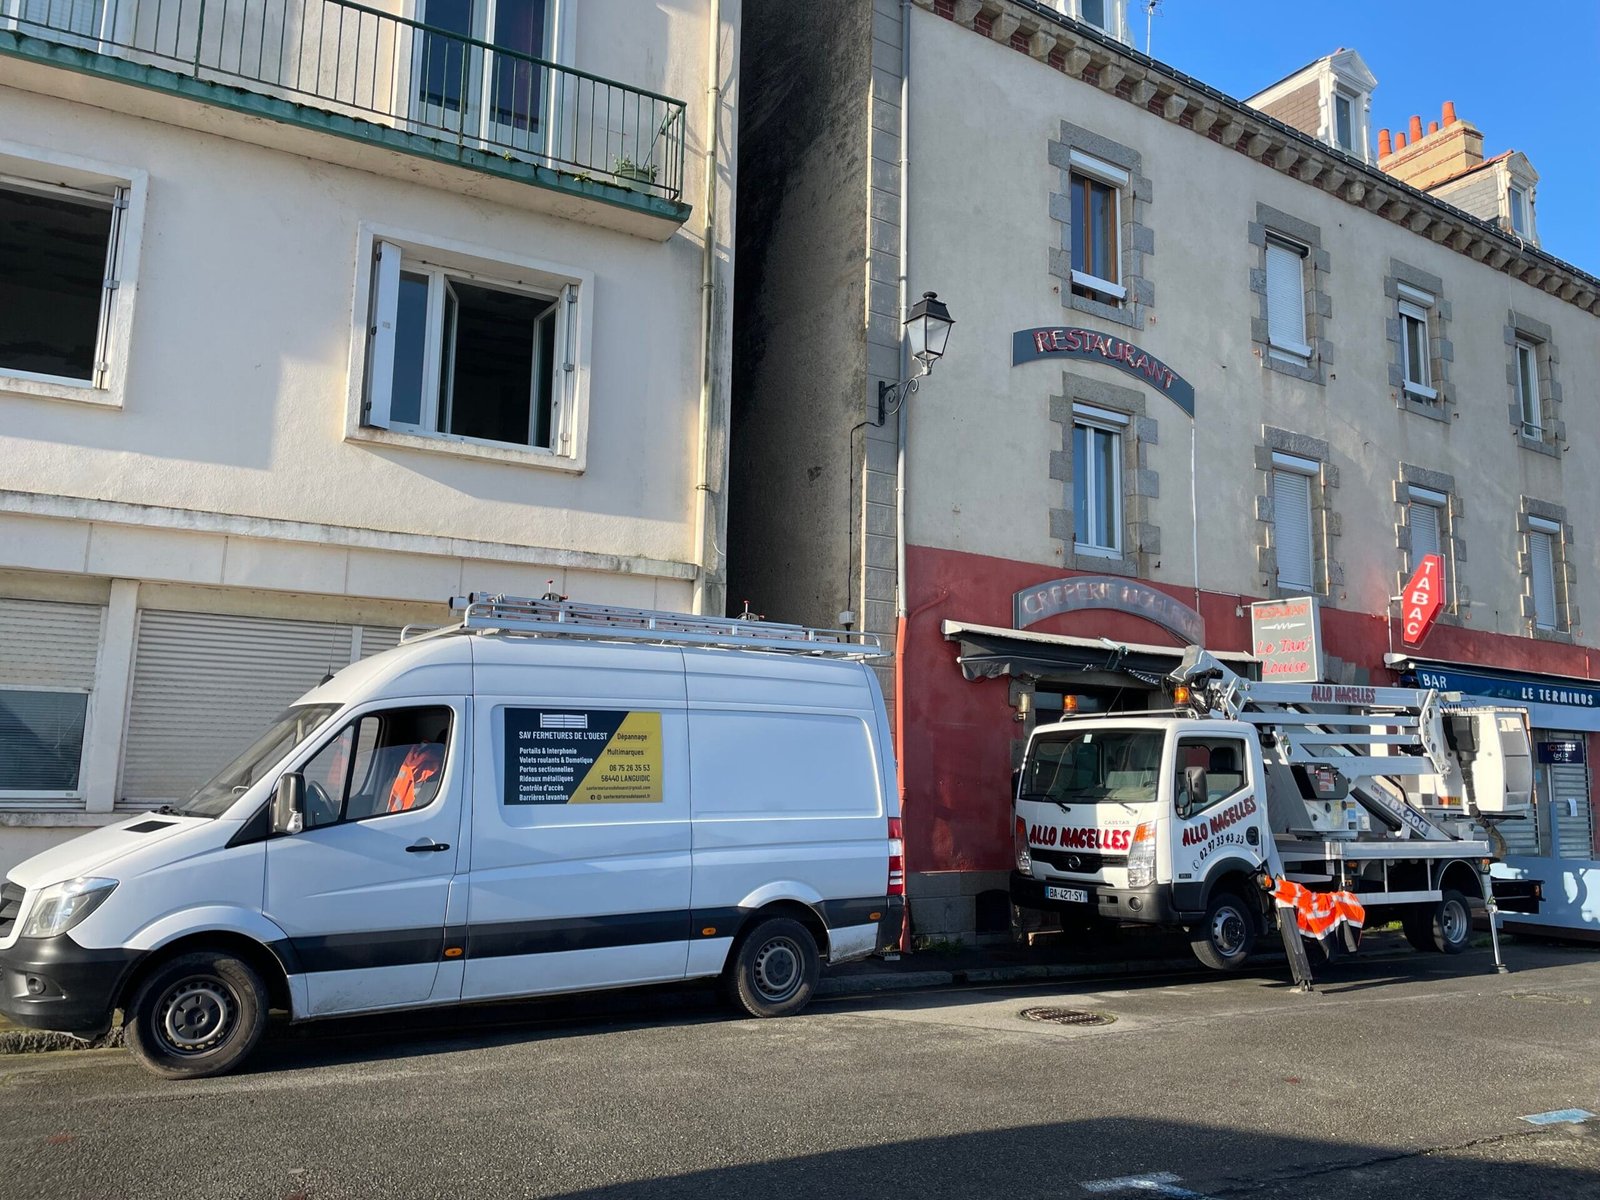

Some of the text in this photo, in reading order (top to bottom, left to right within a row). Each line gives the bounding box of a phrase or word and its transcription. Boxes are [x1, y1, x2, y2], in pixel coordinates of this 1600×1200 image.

[1032, 329, 1178, 390] RESTAURANT
[1407, 561, 1435, 636] TABAC
[1262, 661, 1309, 676] Louise
[1423, 673, 1447, 688] BAR
[1311, 686, 1376, 703] ALLO NACELLES
[1522, 687, 1534, 699] LE
[1539, 689, 1593, 705] TERMINUS
[519, 731, 608, 740] SAV FERMETURES DE L'OUEST
[607, 749, 644, 757] Multimarques
[1182, 795, 1257, 847] ALLO NACELLES
[1029, 824, 1131, 851] ALLO NACELLES
[1200, 833, 1244, 860] 02 97 33 43 33
